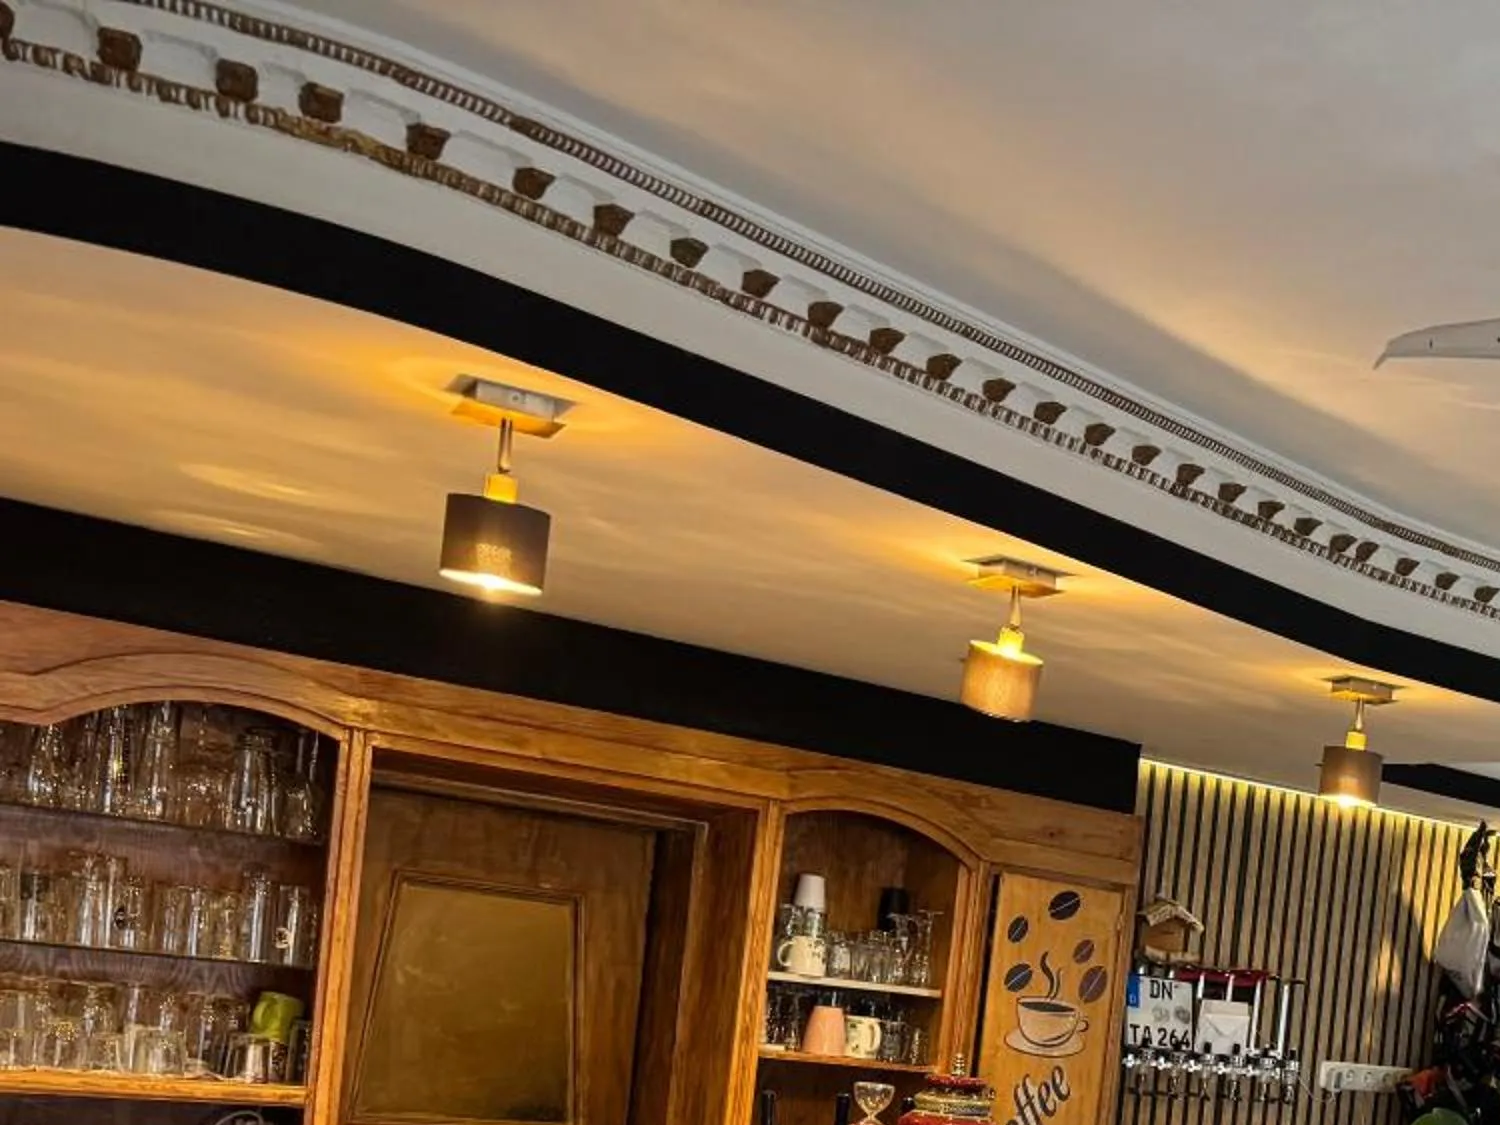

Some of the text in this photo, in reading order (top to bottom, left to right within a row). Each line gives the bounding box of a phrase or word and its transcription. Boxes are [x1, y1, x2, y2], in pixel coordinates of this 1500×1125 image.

[1149, 979, 1173, 1000] DN
[1129, 1023, 1190, 1049] TA 264
